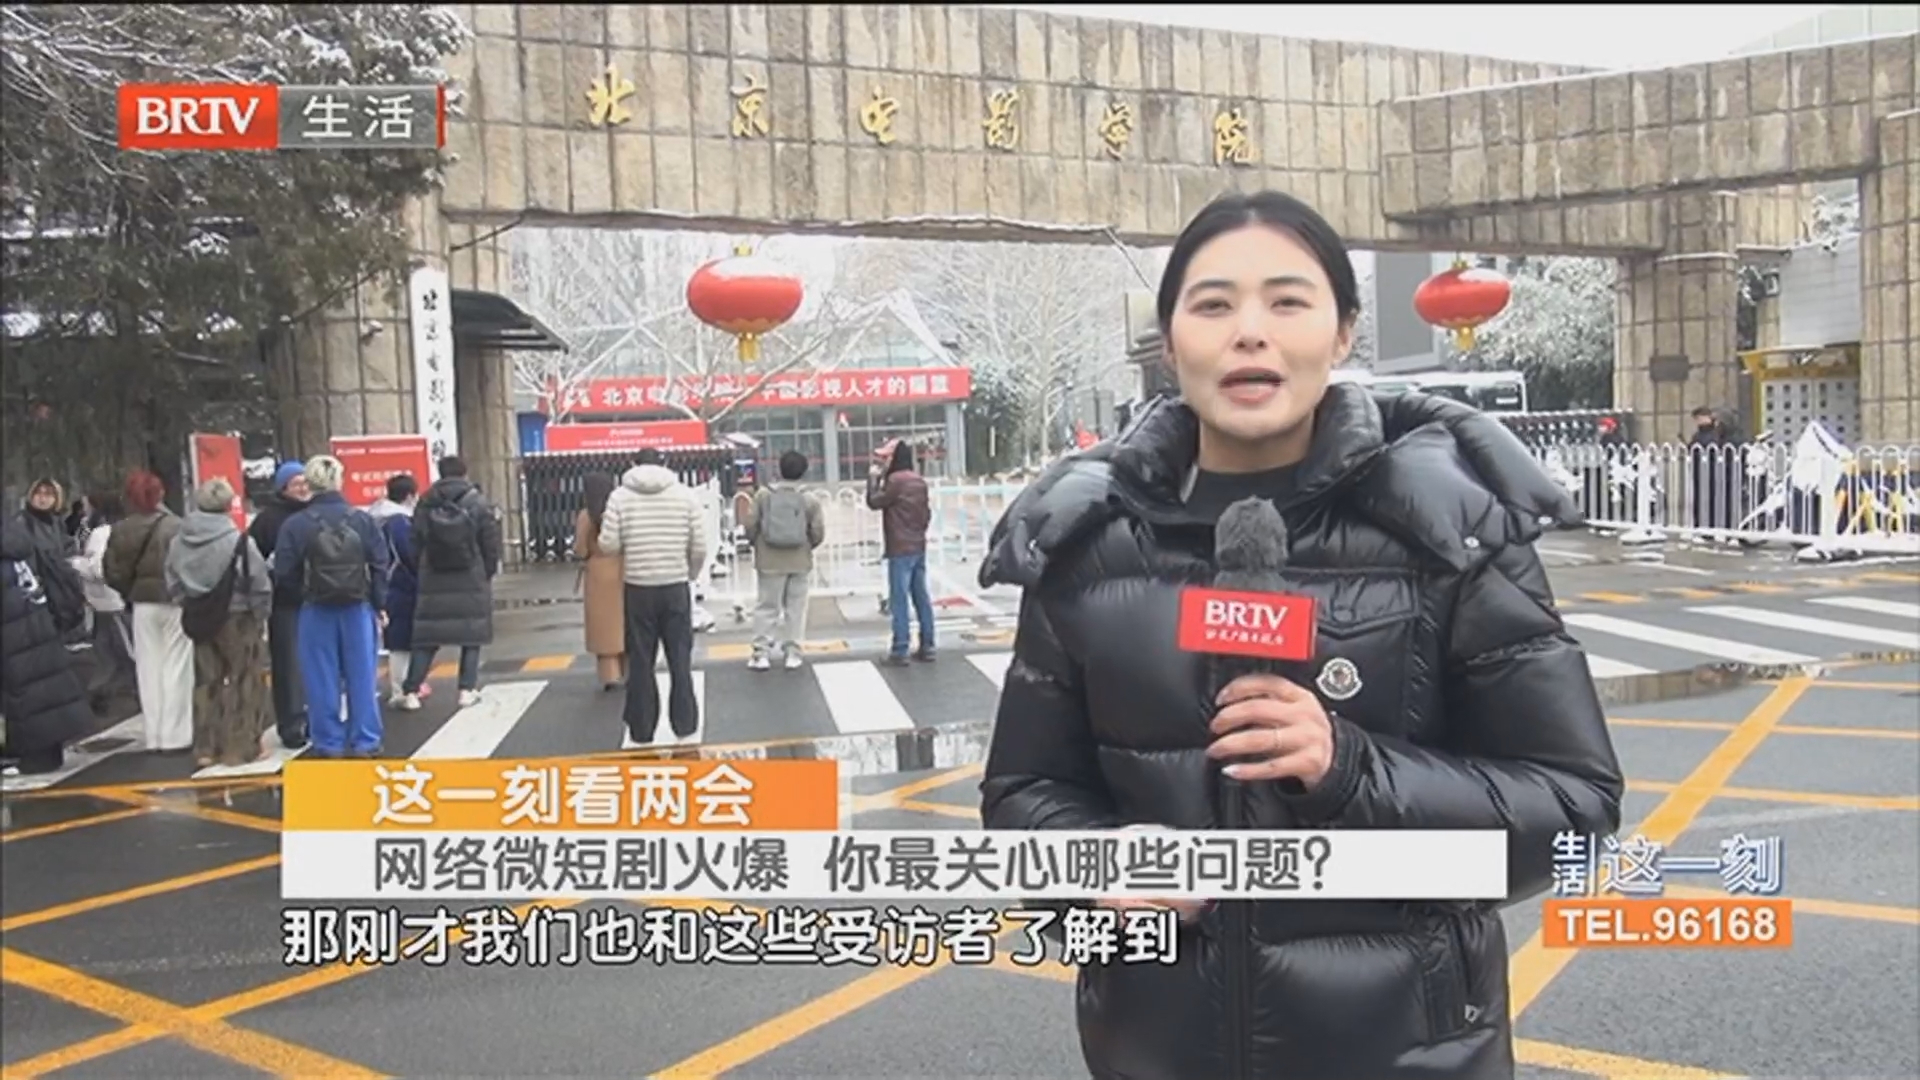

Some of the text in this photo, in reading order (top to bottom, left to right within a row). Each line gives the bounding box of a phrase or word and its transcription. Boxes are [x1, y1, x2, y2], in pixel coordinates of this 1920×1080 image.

[584, 65, 1259, 167] 北京电影学院
[1204, 598, 1289, 631] BRTV
